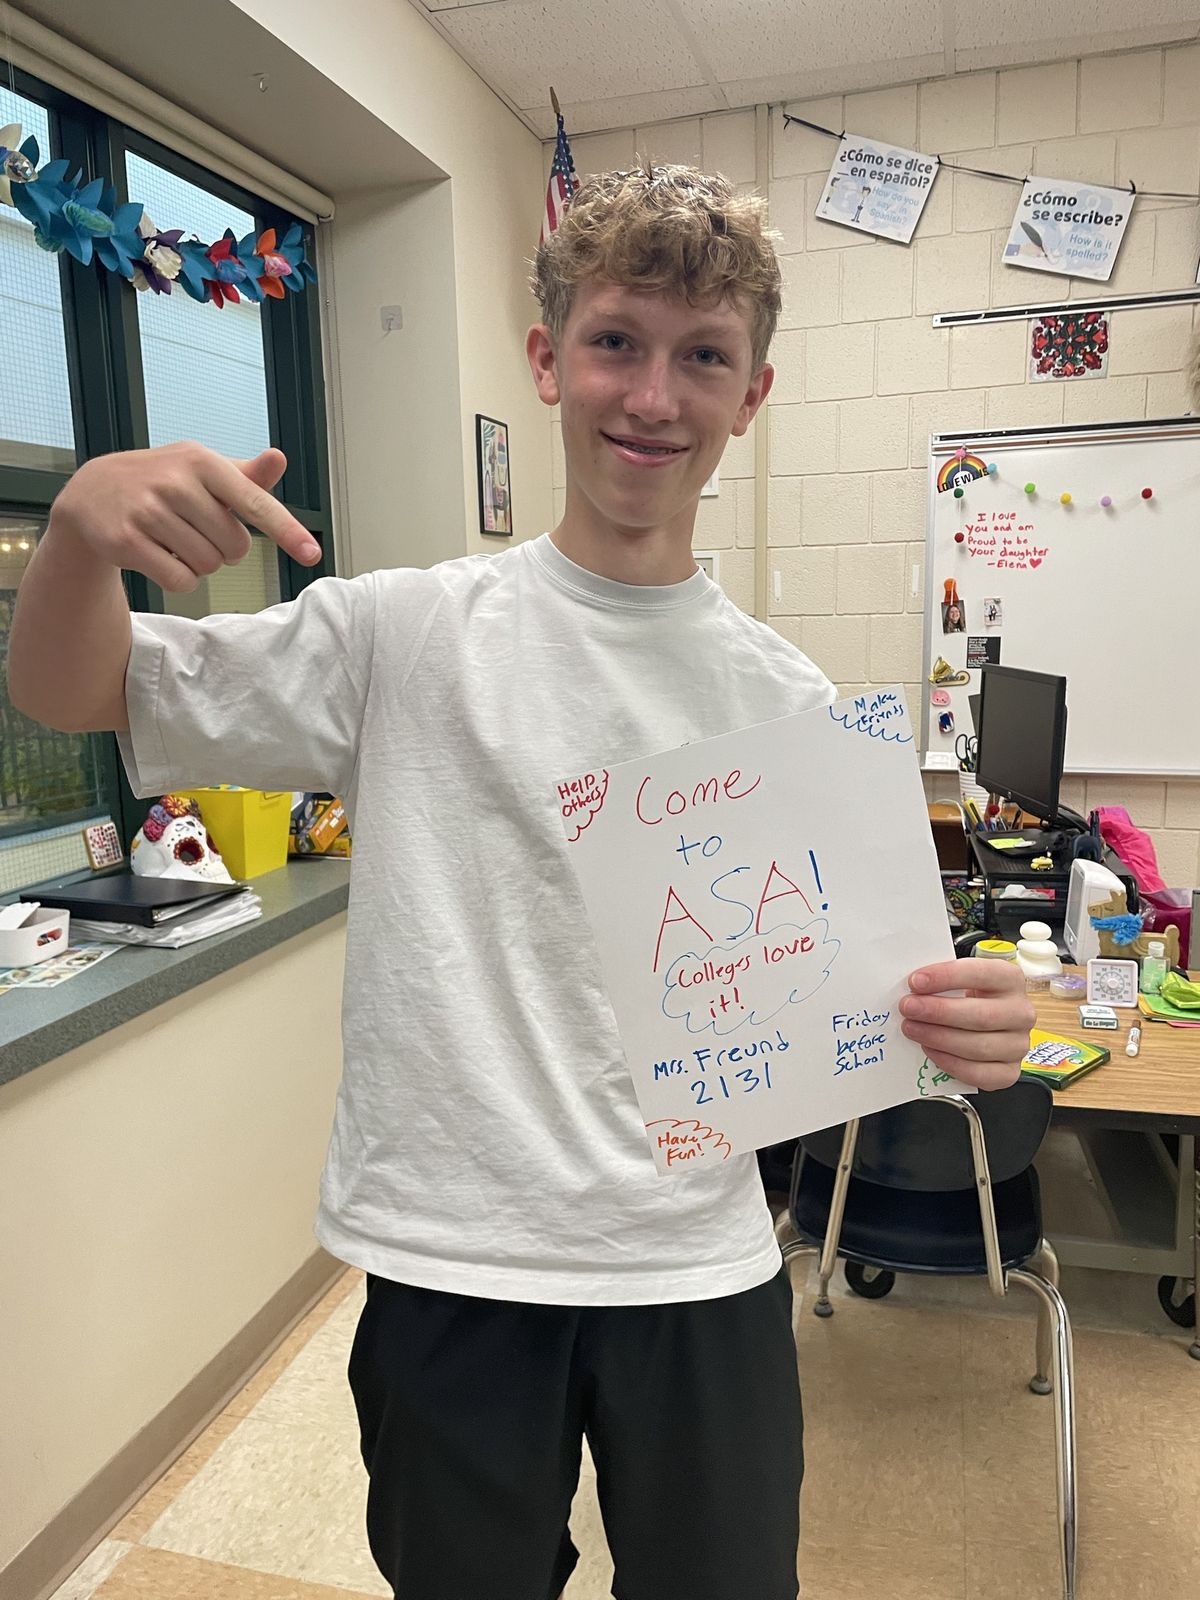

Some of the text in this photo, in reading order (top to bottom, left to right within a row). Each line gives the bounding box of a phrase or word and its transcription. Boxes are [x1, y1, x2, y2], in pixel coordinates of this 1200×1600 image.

[839, 148, 933, 174] ¿Cómo se dice
[850, 166, 930, 189] en español?
[1023, 190, 1078, 207] ¿Cómo
[1031, 209, 1124, 227] se escribe?
[1069, 233, 1092, 245] How
[977, 512, 1017, 522] I love
[993, 522, 1012, 532] and
[1002, 537, 1013, 546] to
[1016, 536, 1029, 545] be
[999, 546, 1049, 561] daughter
[636, 769, 762, 825] Come
[676, 834, 723, 866] to
[652, 849, 829, 974] ASA!
[763, 936, 816, 964] love
[709, 987, 745, 1019] it!
[832, 1009, 890, 1033] Friday
[654, 1030, 790, 1081] Mrs. Freund
[836, 1033, 887, 1057] before
[690, 1061, 772, 1105] 2131
[657, 1131, 699, 1148] Have
[667, 1142, 705, 1167] Fun!
